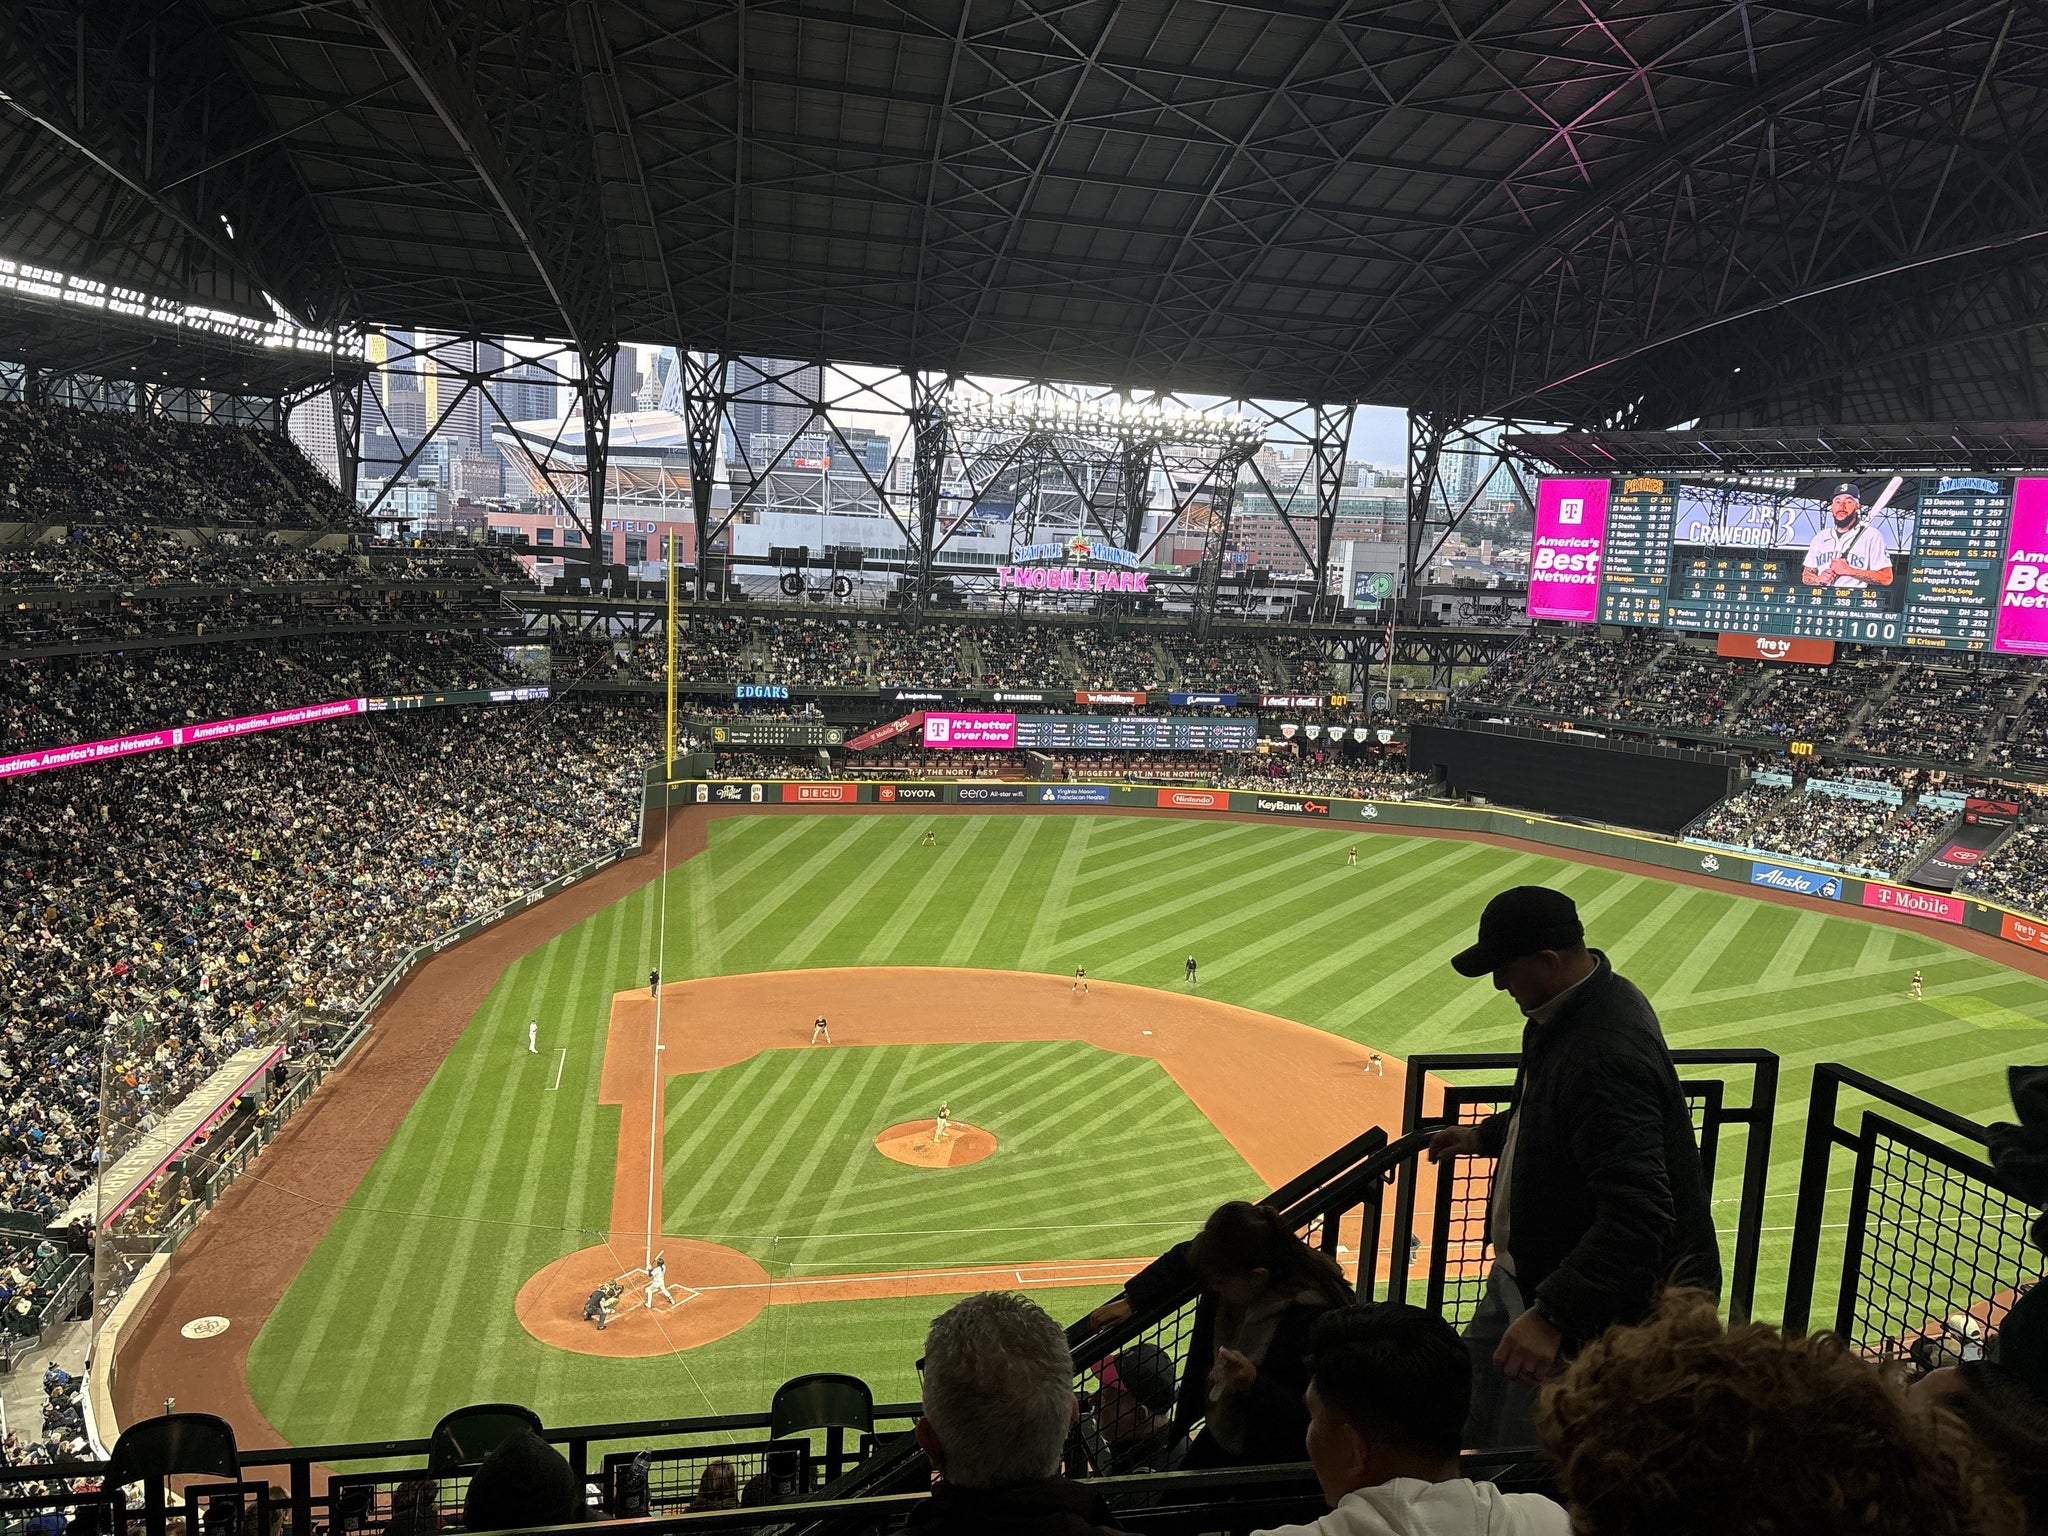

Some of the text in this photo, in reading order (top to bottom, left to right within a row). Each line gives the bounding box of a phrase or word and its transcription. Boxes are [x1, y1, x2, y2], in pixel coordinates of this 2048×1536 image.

[1624, 478, 1664, 494] PADRES
[1936, 477, 1999, 494] MARINERS
[1924, 498, 1932, 506] 33
[610, 520, 657, 533] FIELD
[1689, 520, 1772, 546] CRAWFORD
[1536, 536, 1600, 548] America's
[1013, 542, 1140, 568] SEATTLE MARINERS
[1534, 548, 1600, 572] Best
[1816, 550, 1865, 569] MARRS
[1740, 562, 1752, 570] RBI
[996, 566, 1150, 592] T-MOBILE PARK
[1532, 570, 1598, 584] Network
[1761, 572, 1777, 580] .714
[1960, 578, 1980, 586] Third
[1958, 588, 1974, 596] Song
[1786, 596, 1796, 604] 22
[1834, 598, 1850, 606] .358
[1860, 600, 1878, 608] .356
[1676, 619, 1700, 627] Mariners
[1918, 617, 1940, 625] Young
[1866, 622, 1895, 640] 0 0
[1916, 626, 1942, 634] Pereda
[1757, 638, 1790, 651] fire tv
[1917, 638, 1946, 646] Criswell
[193, 704, 351, 738] America's pastime. America's Best Network.
[952, 720, 1012, 730] It's better
[876, 727, 894, 738] Mobile
[892, 719, 910, 732] Pen
[954, 732, 1010, 741] over here
[42, 748, 95, 766] America's
[96, 744, 118, 756] Best
[120, 735, 164, 752] Network.
[926, 768, 943, 776] THE
[946, 768, 999, 776] NORTHEST
[1145, 770, 1152, 778] IN
[802, 788, 840, 797] BECU
[898, 790, 936, 798] TOYOTA
[960, 788, 988, 798] eero
[1057, 788, 1078, 796] Virginia
[1820, 782, 1888, 796] J-ROD SQUAD
[1176, 796, 1212, 804] Nintendo
[1258, 800, 1303, 812] KeyBank
[1931, 858, 1969, 870] TOYO
[1756, 869, 1811, 892] Alaska
[526, 889, 544, 906] STIHL
[1894, 892, 1949, 915] Mobile
[2014, 922, 2036, 936] fire tv
